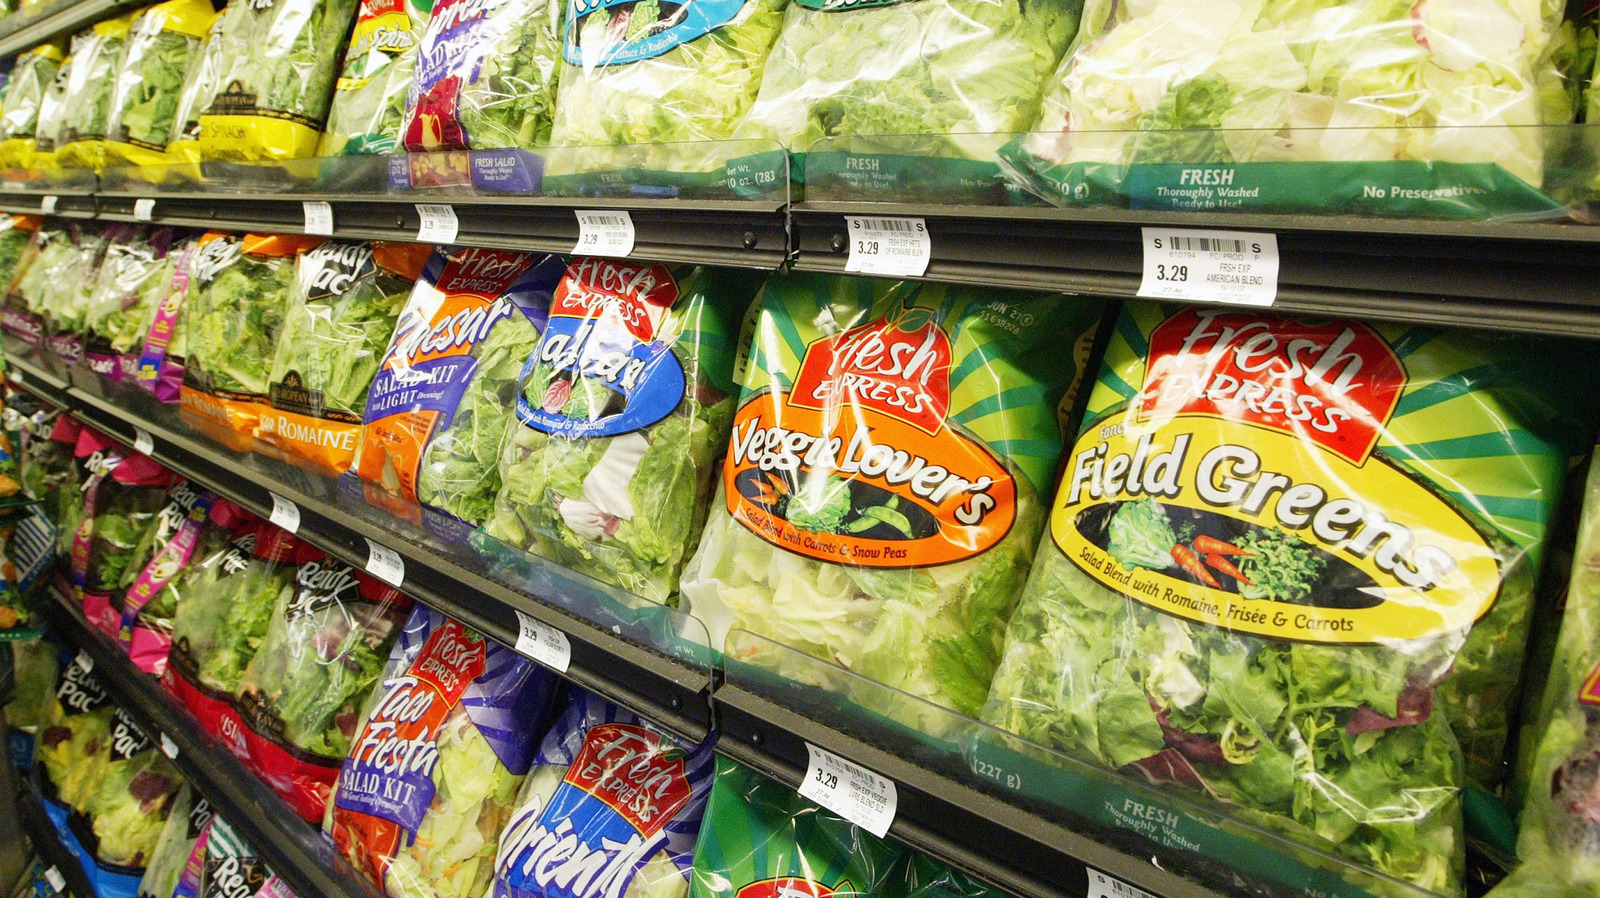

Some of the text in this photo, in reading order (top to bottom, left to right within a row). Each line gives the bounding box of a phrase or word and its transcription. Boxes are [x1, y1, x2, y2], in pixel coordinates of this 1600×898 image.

[475, 157, 493, 167] FRESH
[755, 170, 775, 186] (283
[846, 157, 880, 170] FRESH
[1180, 169, 1235, 185] FRESH
[1157, 186, 1259, 199] Thoroughly Washed
[1172, 198, 1203, 209] Ready
[1205, 200, 1216, 208] to
[1363, 185, 1386, 198] No
[583, 233, 598, 245] 3.29
[853, 220, 925, 232] S S
[858, 240, 879, 255] 3.29
[1154, 238, 1261, 254] S S
[1169, 251, 1196, 259] 610794
[458, 247, 526, 282] Fresh
[570, 255, 657, 304] Fresh
[1156, 264, 1188, 282] 3.29
[1206, 273, 1263, 285] AMERICAN BLEND
[1219, 262, 1251, 273] FRSH EXP
[446, 277, 503, 294] EXPRESS
[561, 290, 646, 328] EXPRESS
[987, 300, 1008, 315] JUN
[1009, 309, 1023, 321] 27
[827, 322, 939, 387] Fresh
[1174, 308, 1365, 399] Fresh
[426, 364, 458, 385] KIT
[381, 389, 419, 411] LIGHT
[416, 390, 445, 401] Dressing!
[812, 372, 932, 415] EXPRESS
[1162, 373, 1351, 435] EXPRESS
[277, 415, 356, 452] ROMAINE
[1098, 420, 1133, 443] Fancy
[731, 416, 998, 527] Veggie Lover's
[1065, 433, 1459, 593] Field Greens
[744, 507, 763, 527] Salad
[783, 531, 801, 546] with
[804, 537, 837, 555] Carrots
[840, 543, 850, 555] &
[853, 544, 880, 558] Snow
[883, 546, 908, 559] Peas
[297, 561, 361, 603] Ready
[1079, 546, 1354, 632] Salad Blend with Romaine, Frisée & Carrots
[433, 622, 482, 675] Fresh
[420, 657, 460, 693] EXPRESS
[60, 680, 90, 713] Pac
[370, 676, 435, 724] Taco
[114, 723, 140, 760] Pac
[353, 720, 440, 777] Fiesta
[596, 728, 679, 800] Fresh
[815, 768, 838, 790] 3.29
[973, 756, 1021, 790] (227 g)
[342, 768, 417, 805] SALAD KIT
[581, 761, 659, 823] EXPRESS
[861, 786, 871, 796] EXP
[871, 790, 888, 806] VEGGIE
[190, 799, 213, 832] Pa
[860, 794, 876, 808] BLEND
[874, 802, 885, 814] SLD
[1123, 798, 1180, 829] FRESH
[1104, 801, 1158, 834] Thoroughly
[1161, 825, 1200, 852] Washed
